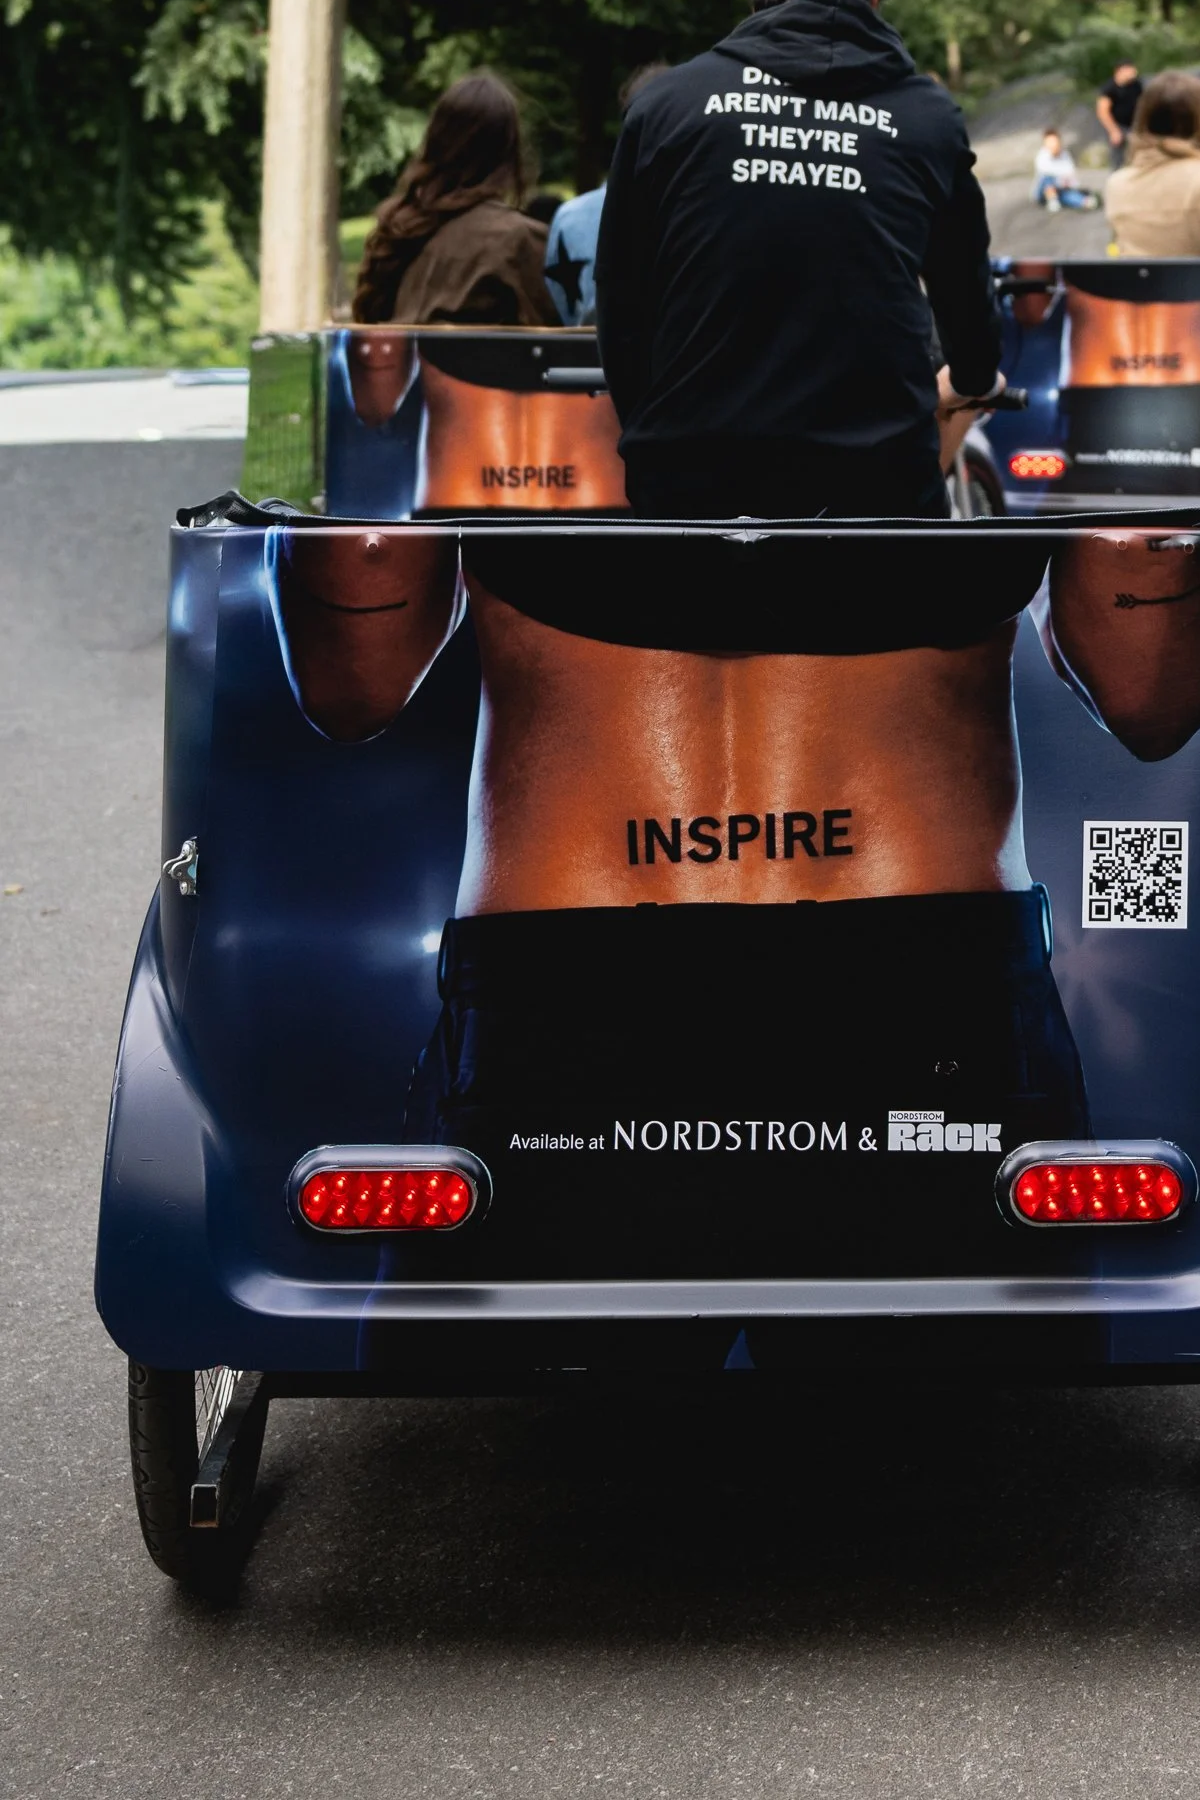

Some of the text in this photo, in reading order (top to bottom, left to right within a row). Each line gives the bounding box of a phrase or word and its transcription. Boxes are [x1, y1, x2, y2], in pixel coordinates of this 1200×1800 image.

[704, 92, 898, 138] AREN'T MADE,
[740, 123, 859, 156] THEY'RE
[732, 158, 867, 193] SPRAYED.
[482, 465, 576, 488] INSPIRE
[627, 809, 853, 865] INSPIRE
[890, 1112, 942, 1120] NORDSTROM
[509, 1133, 584, 1150] Available
[588, 1134, 605, 1150] at
[614, 1120, 848, 1152] NORDSTROM
[858, 1126, 878, 1151] &
